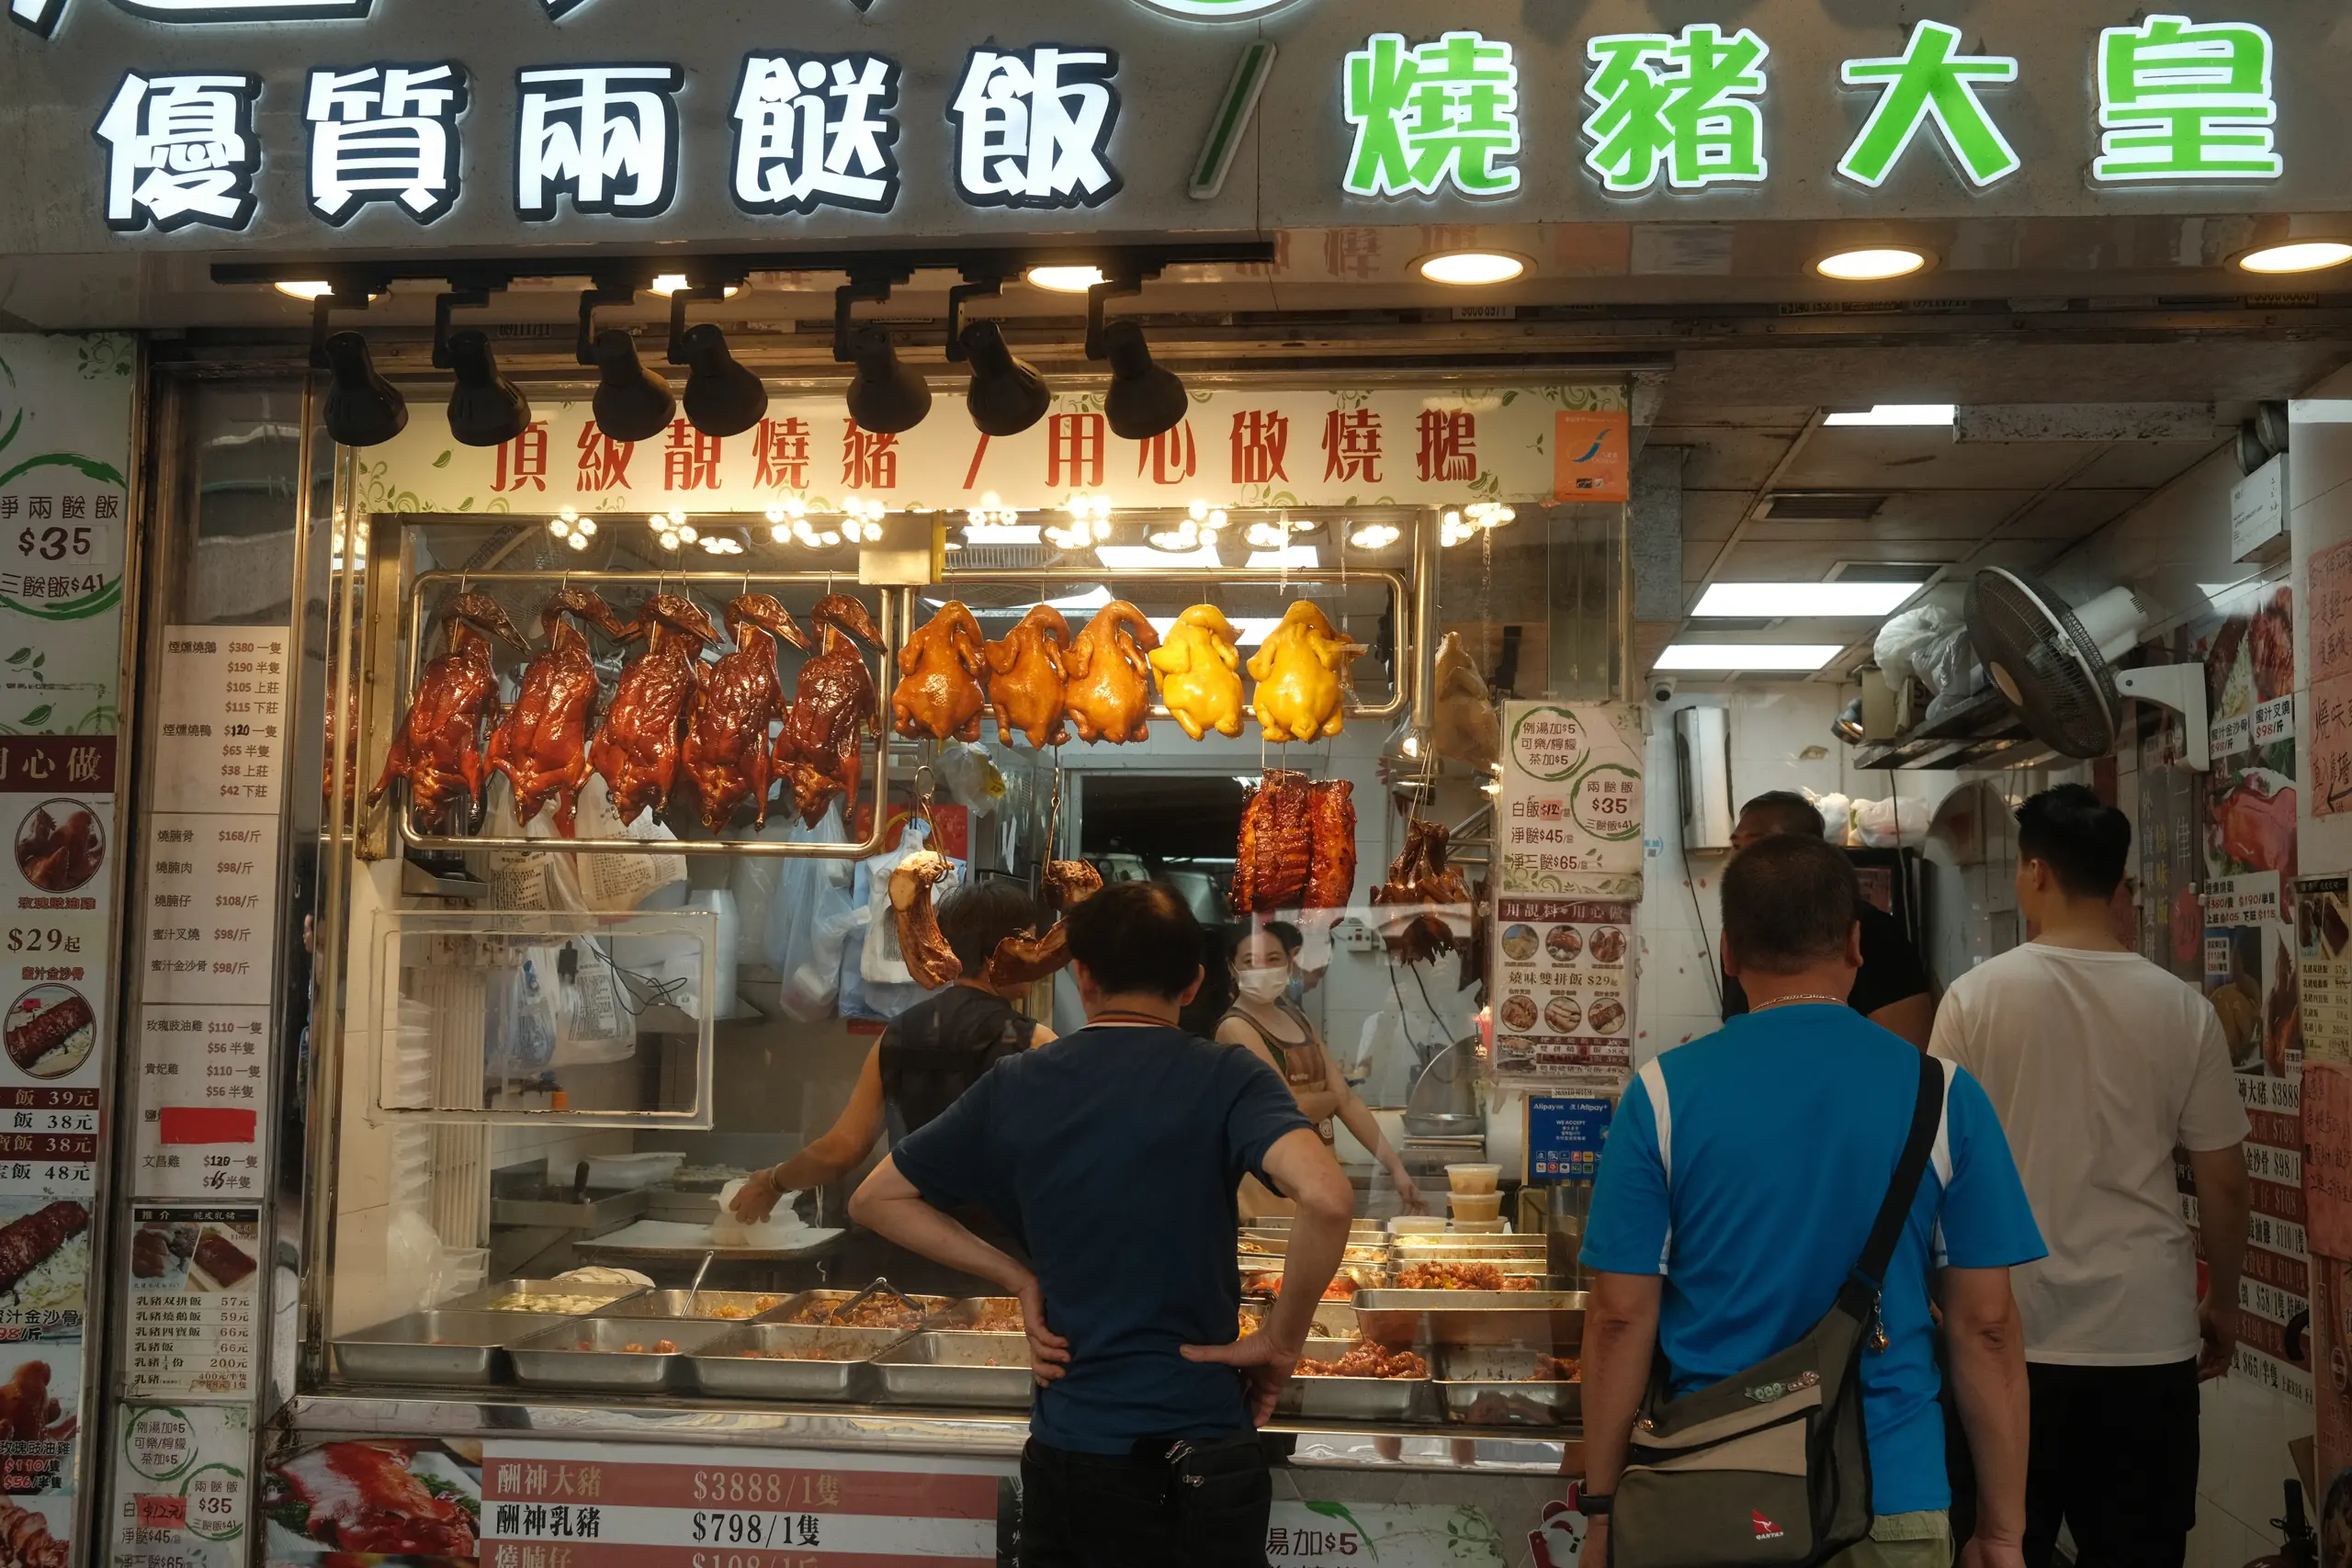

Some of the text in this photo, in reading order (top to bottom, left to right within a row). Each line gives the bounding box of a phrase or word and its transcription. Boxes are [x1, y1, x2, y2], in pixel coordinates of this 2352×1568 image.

[96, 46, 1119, 226] 優質兩餸飯
[1342, 13, 2284, 196] 燒豬大皇
[490, 417, 897, 492] 頂級靚燒豬
[1045, 407, 1476, 485] 用心做燒鵝
[18, 526, 91, 560] $35
[228, 641, 254, 653] $380
[256, 641, 282, 655] 一隻
[227, 660, 280, 675] $190 半隻
[226, 681, 252, 693] $105
[225, 701, 251, 713] $115
[223, 724, 250, 737] $120
[252, 725, 277, 739] 一隻
[1522, 721, 1576, 734] 例湯加$5
[222, 744, 270, 759] $65 半隻
[1521, 738, 1577, 751] 可樂/檸檬
[0, 746, 101, 783] 心做
[1529, 753, 1568, 766] 茶加$5
[221, 764, 241, 776] $38
[220, 784, 240, 796] $42
[1592, 797, 1627, 814] $35
[219, 829, 262, 843] $168/斤
[217, 861, 254, 875] $98/斤
[215, 894, 259, 908] $108/斤
[7, 927, 81, 953] $29起
[153, 929, 252, 942] 蜜汁叉燒 $98/斤
[22, 966, 85, 981] 蜜汁金沙骨
[212, 961, 250, 976] $98/斤
[208, 1021, 234, 1033] $110
[236, 1021, 263, 1035] 一隻
[208, 1041, 255, 1055] $56 半隻
[207, 1065, 232, 1077] $110
[235, 1065, 261, 1078] 一隻
[48, 1090, 94, 1107] 39元
[206, 1085, 254, 1100] $56 半隻
[47, 1113, 93, 1131] 38元
[144, 1109, 161, 1122] 鹽
[46, 1136, 92, 1153] 38元
[203, 1155, 231, 1168] $120
[232, 1156, 258, 1169] 一隻
[45, 1164, 90, 1181] 48元
[226, 1175, 252, 1189] 半隻
[220, 1297, 249, 1306] 57元
[0, 1309, 79, 1325] 汁金沙骨
[220, 1312, 249, 1322] 59元
[220, 1327, 249, 1337] 66元
[210, 1358, 248, 1368] 200元
[141, 1452, 178, 1465] 茶加$5
[496, 1462, 842, 1508] 酬神大豬 $3888/1隻
[198, 1497, 232, 1514] $35
[495, 1504, 820, 1548] 酬神乳豬 $798/1隻
